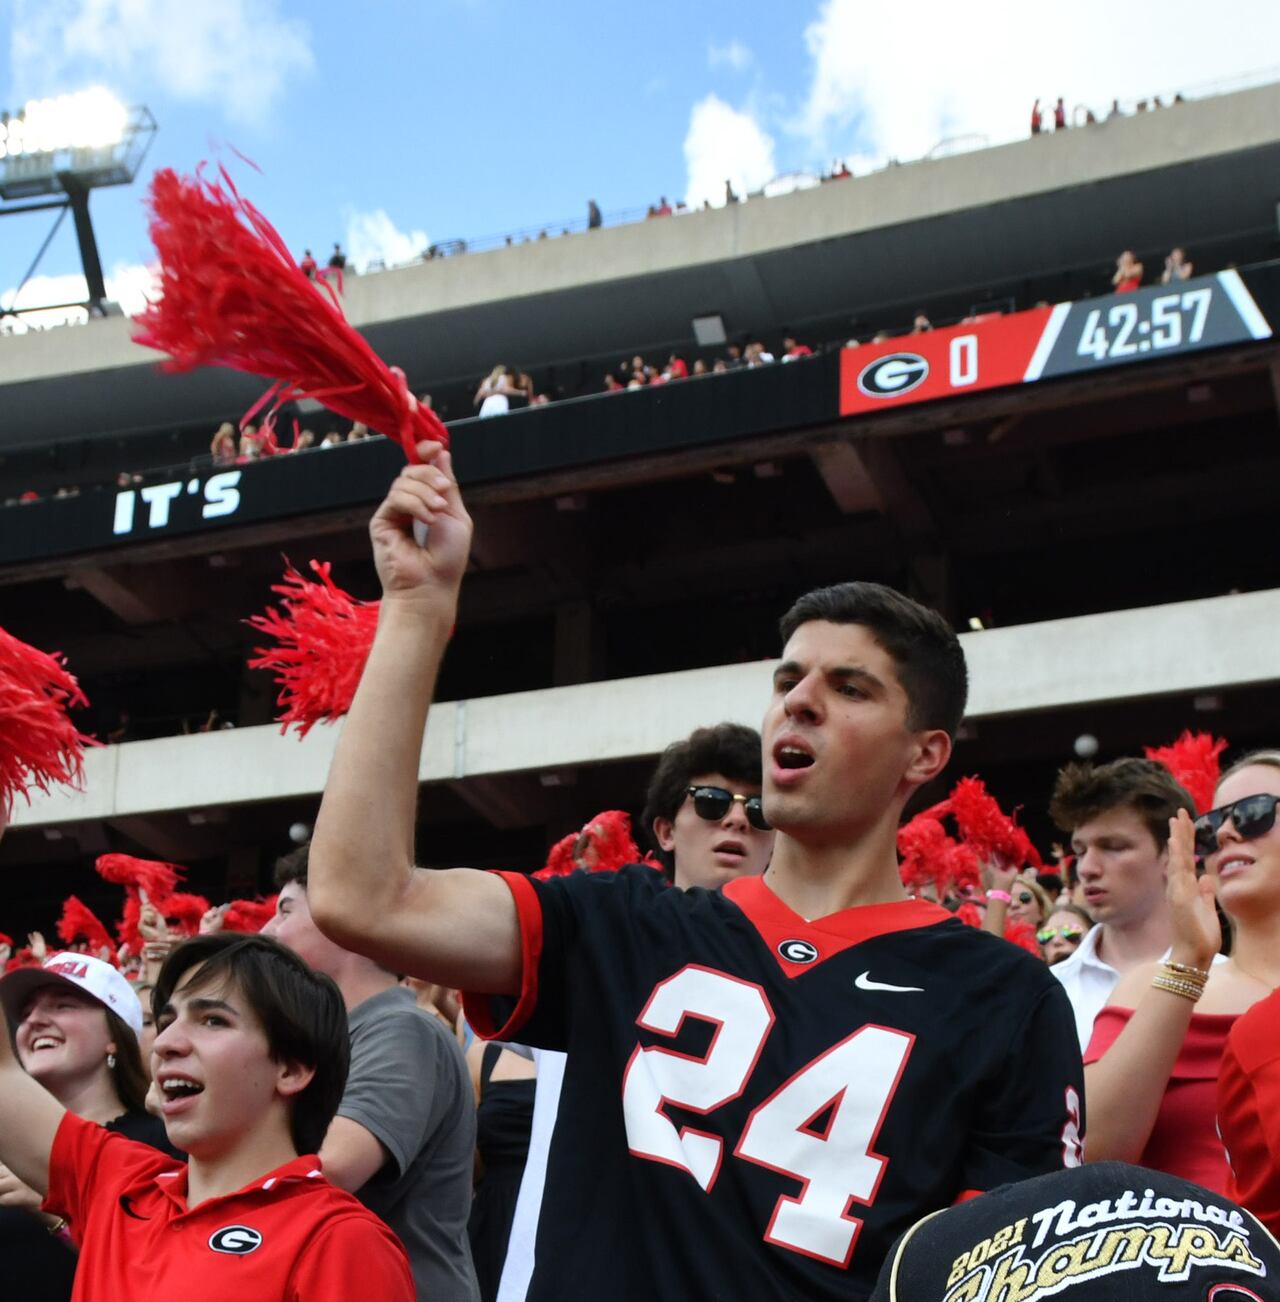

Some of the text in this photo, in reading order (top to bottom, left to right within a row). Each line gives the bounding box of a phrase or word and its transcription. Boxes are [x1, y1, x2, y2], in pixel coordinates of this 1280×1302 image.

[948, 333, 979, 388] 0
[1076, 287, 1215, 361] 42:57
[113, 470, 242, 535] IT'S
[621, 962, 917, 1270] 24
[947, 1188, 1249, 1287] 2021 National
